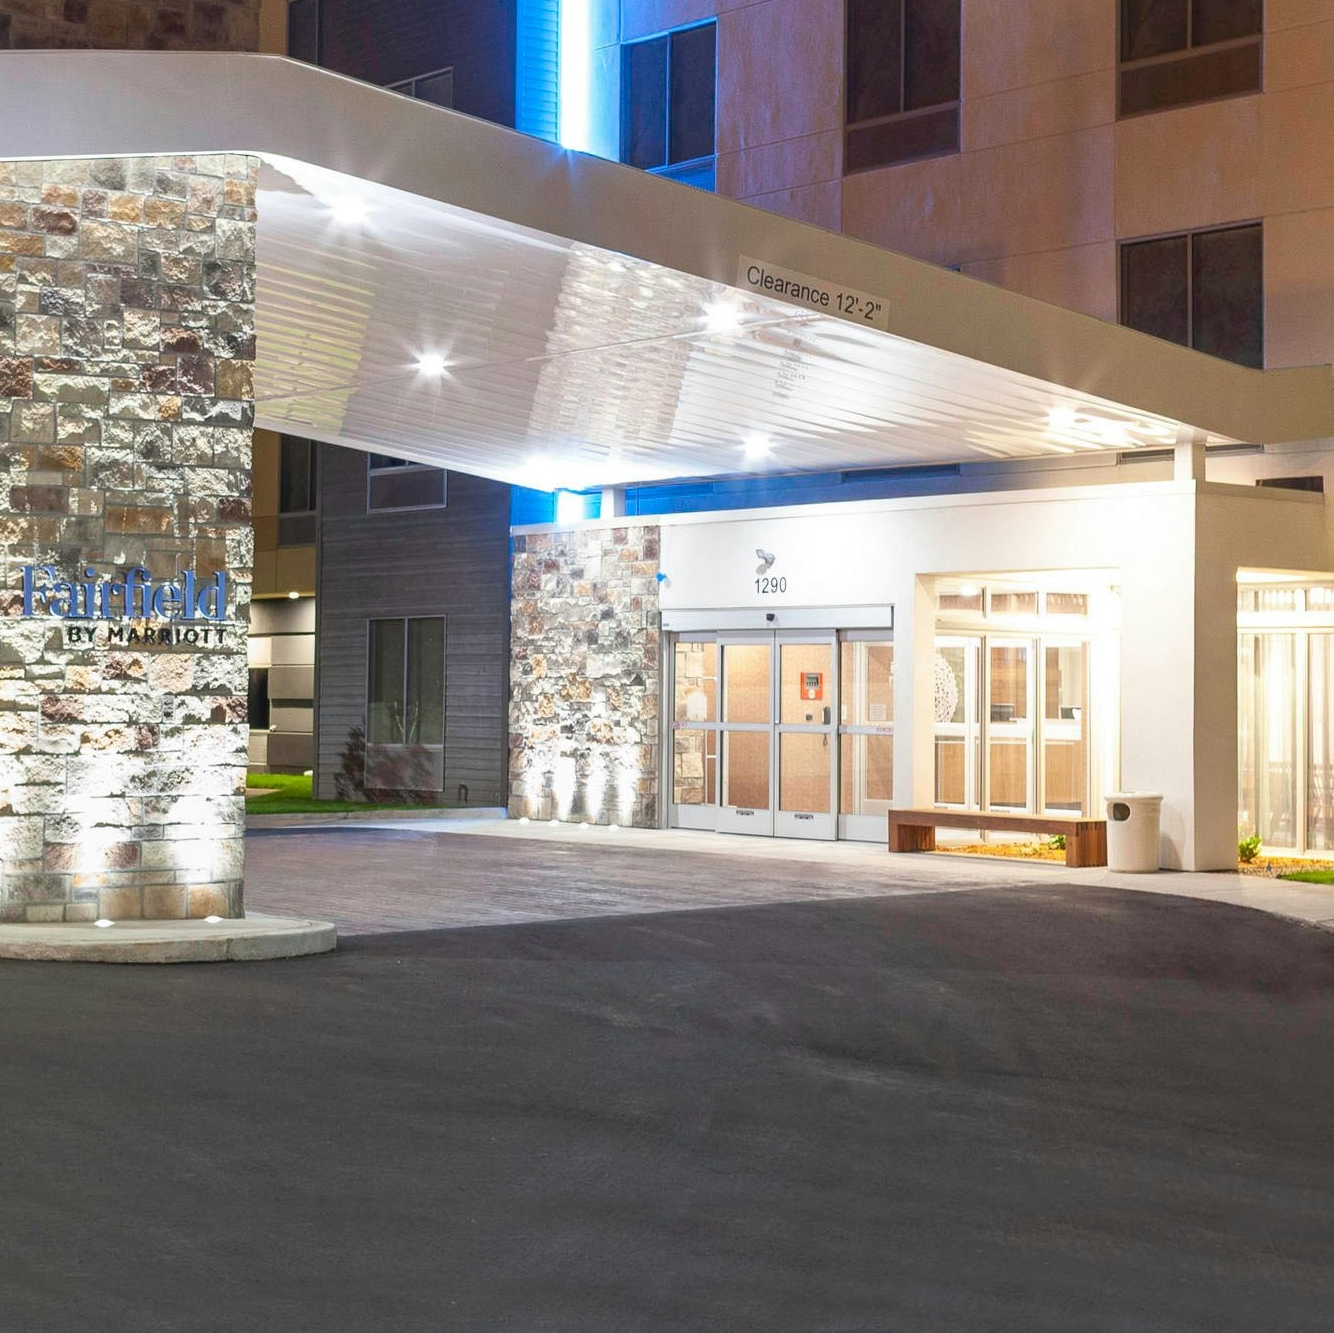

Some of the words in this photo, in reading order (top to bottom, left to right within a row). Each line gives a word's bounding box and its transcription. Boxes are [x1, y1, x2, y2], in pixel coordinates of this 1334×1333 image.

[747, 265, 830, 307] Clearance
[836, 292, 882, 321] 12'-2"
[20, 565, 227, 621] Fairfield
[755, 576, 787, 594] 1290
[68, 626, 97, 643] BY
[107, 626, 227, 645] MARRIOTT
